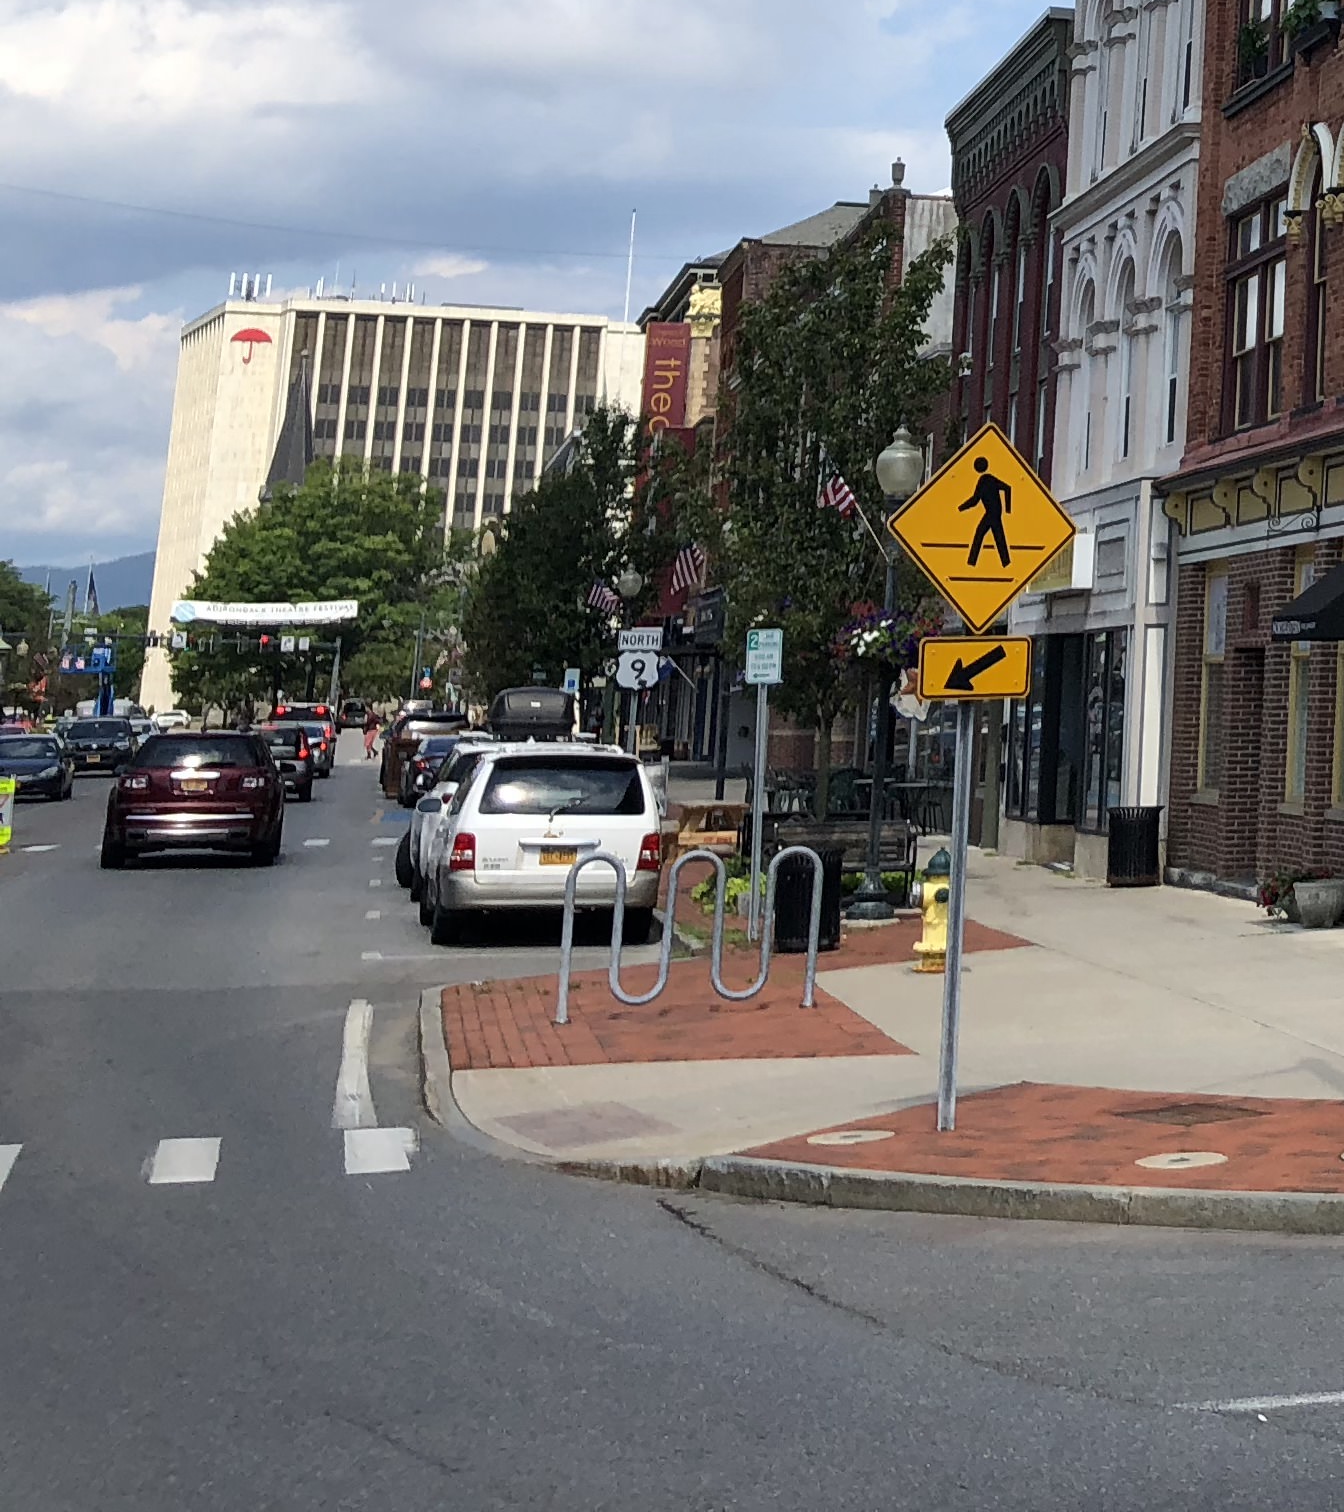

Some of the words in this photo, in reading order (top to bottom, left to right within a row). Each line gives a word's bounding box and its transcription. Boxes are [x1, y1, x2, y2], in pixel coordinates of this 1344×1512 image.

[621, 634, 659, 647] NORTH
[750, 633, 758, 647] 2
[630, 658, 646, 680] 9
